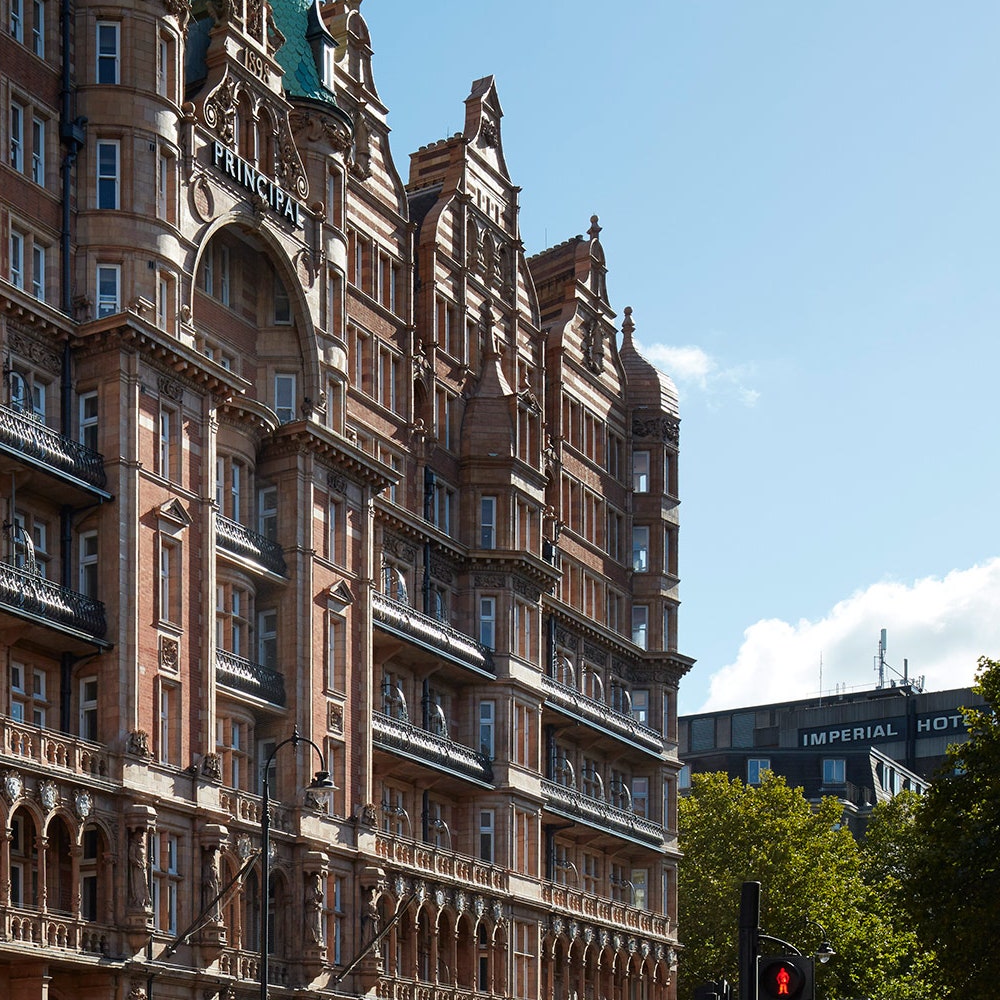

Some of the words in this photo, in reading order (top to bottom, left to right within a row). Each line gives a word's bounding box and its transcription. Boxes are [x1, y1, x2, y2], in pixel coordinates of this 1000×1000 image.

[244, 47, 271, 86] 1898
[213, 141, 304, 229] PRINCIPAL
[803, 723, 898, 747] IMPERIAL
